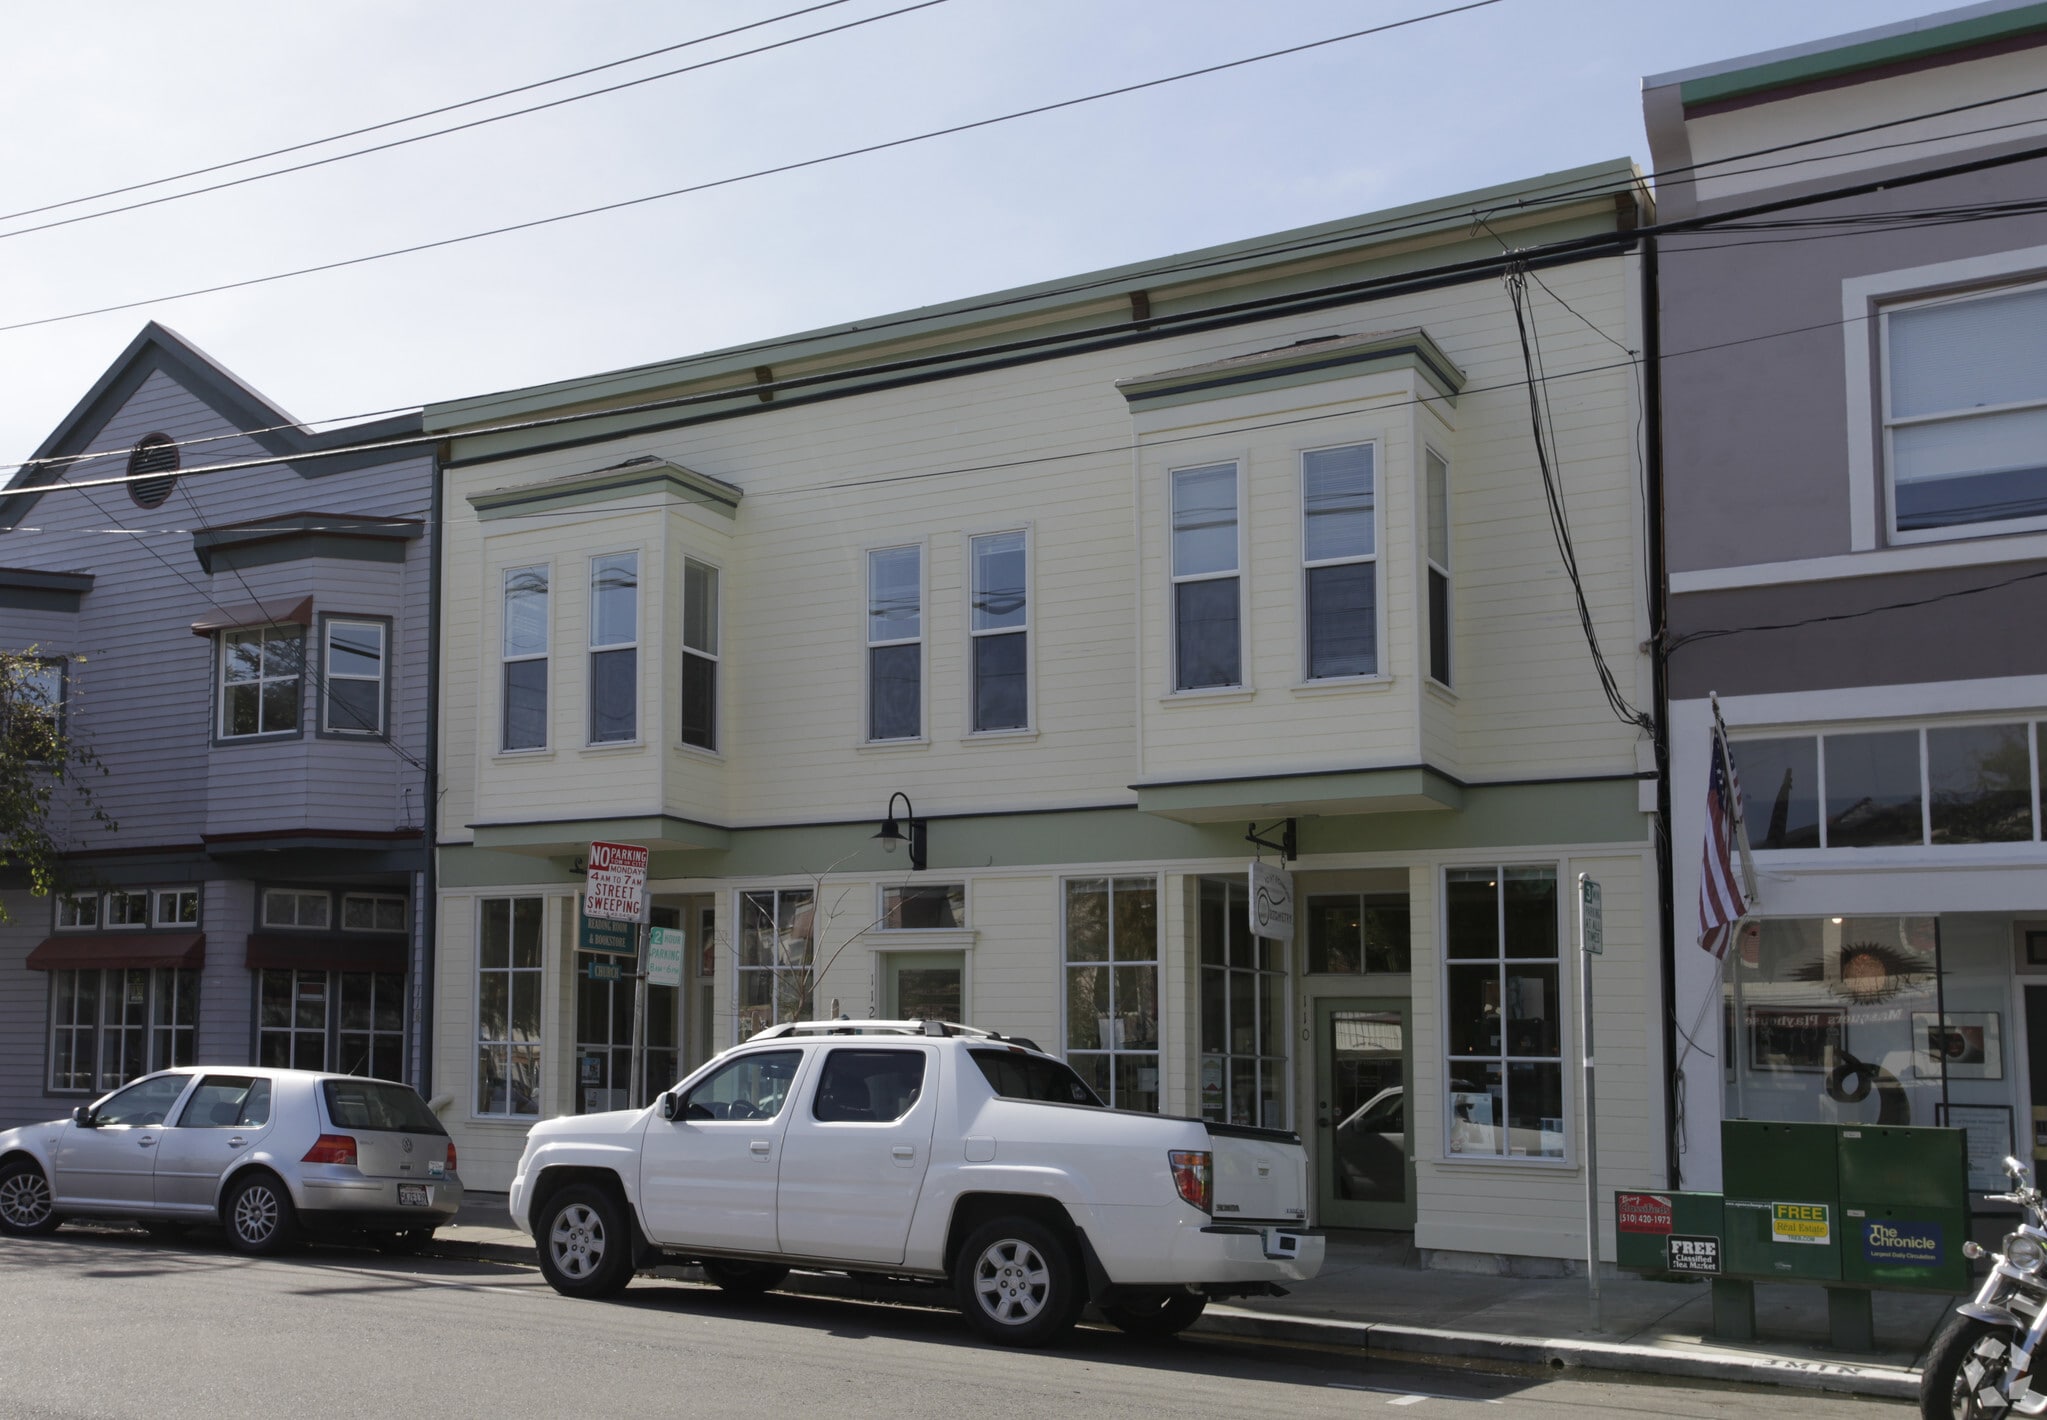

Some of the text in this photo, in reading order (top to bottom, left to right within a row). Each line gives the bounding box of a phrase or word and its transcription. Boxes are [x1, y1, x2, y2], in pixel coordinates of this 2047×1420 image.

[590, 845, 647, 867] NO PARKING
[610, 865, 641, 875] MONDAY
[595, 883, 634, 899] STREET
[587, 896, 640, 914] SWEEPING
[595, 935, 626, 948] BOOKSTORE
[654, 931, 681, 945] 2 HOUR
[651, 947, 680, 961] PARKING
[594, 965, 619, 979] CHURCH
[1619, 1202, 1671, 1215] Classifieds
[1777, 1205, 1823, 1220] FREE
[1620, 1214, 1671, 1225] (510) 420-1972
[1776, 1222, 1825, 1233] Real Estate
[1870, 1224, 1898, 1238] The
[1671, 1240, 1716, 1256] FREE
[1869, 1233, 1936, 1250] Chronicle
[1675, 1254, 1712, 1264] Classified
[1870, 1250, 1891, 1258] Largest
[1906, 1253, 1936, 1261] Circulation
[1689, 1262, 1716, 1270] Market
